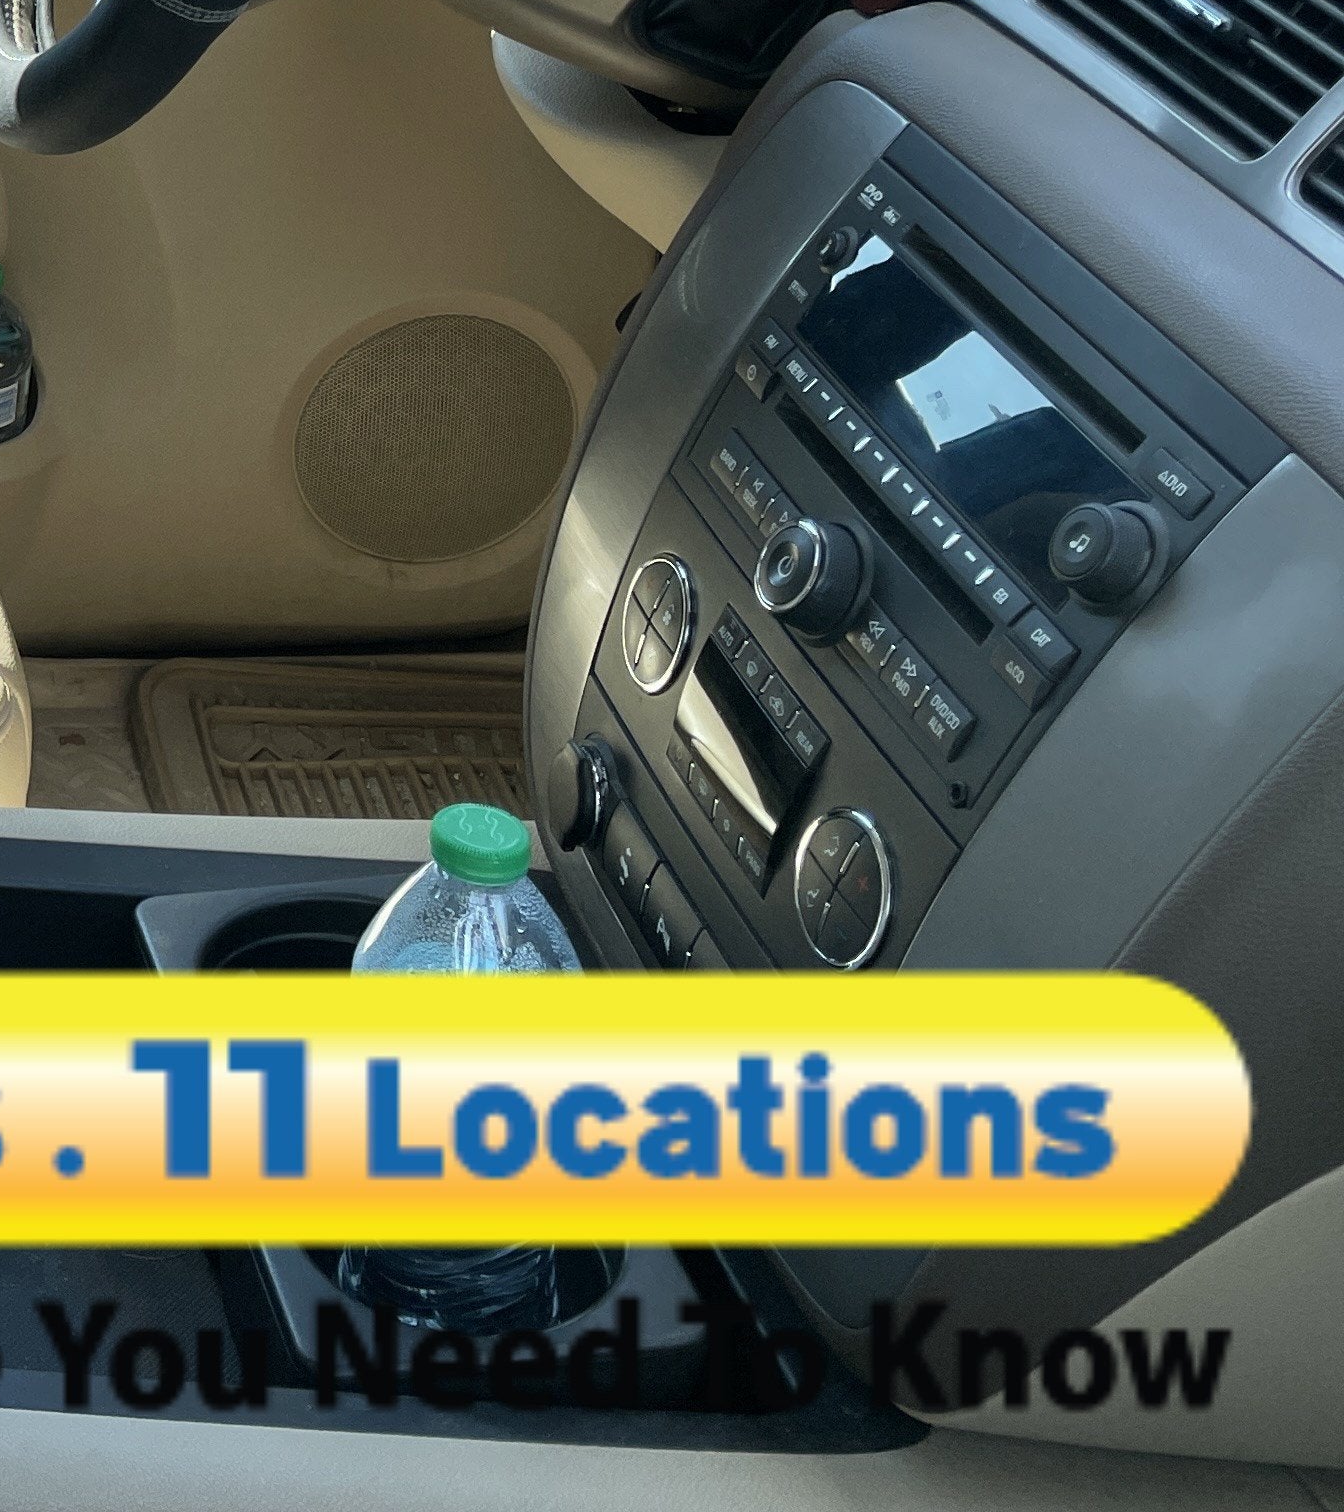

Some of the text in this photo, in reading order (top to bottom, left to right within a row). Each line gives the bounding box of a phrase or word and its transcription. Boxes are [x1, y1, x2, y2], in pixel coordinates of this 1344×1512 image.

[785, 359, 808, 383] MENU
[1165, 473, 1189, 498] DVD
[1030, 627, 1052, 648] CAT
[929, 694, 961, 731] DVD/CD
[927, 715, 947, 740] AUX
